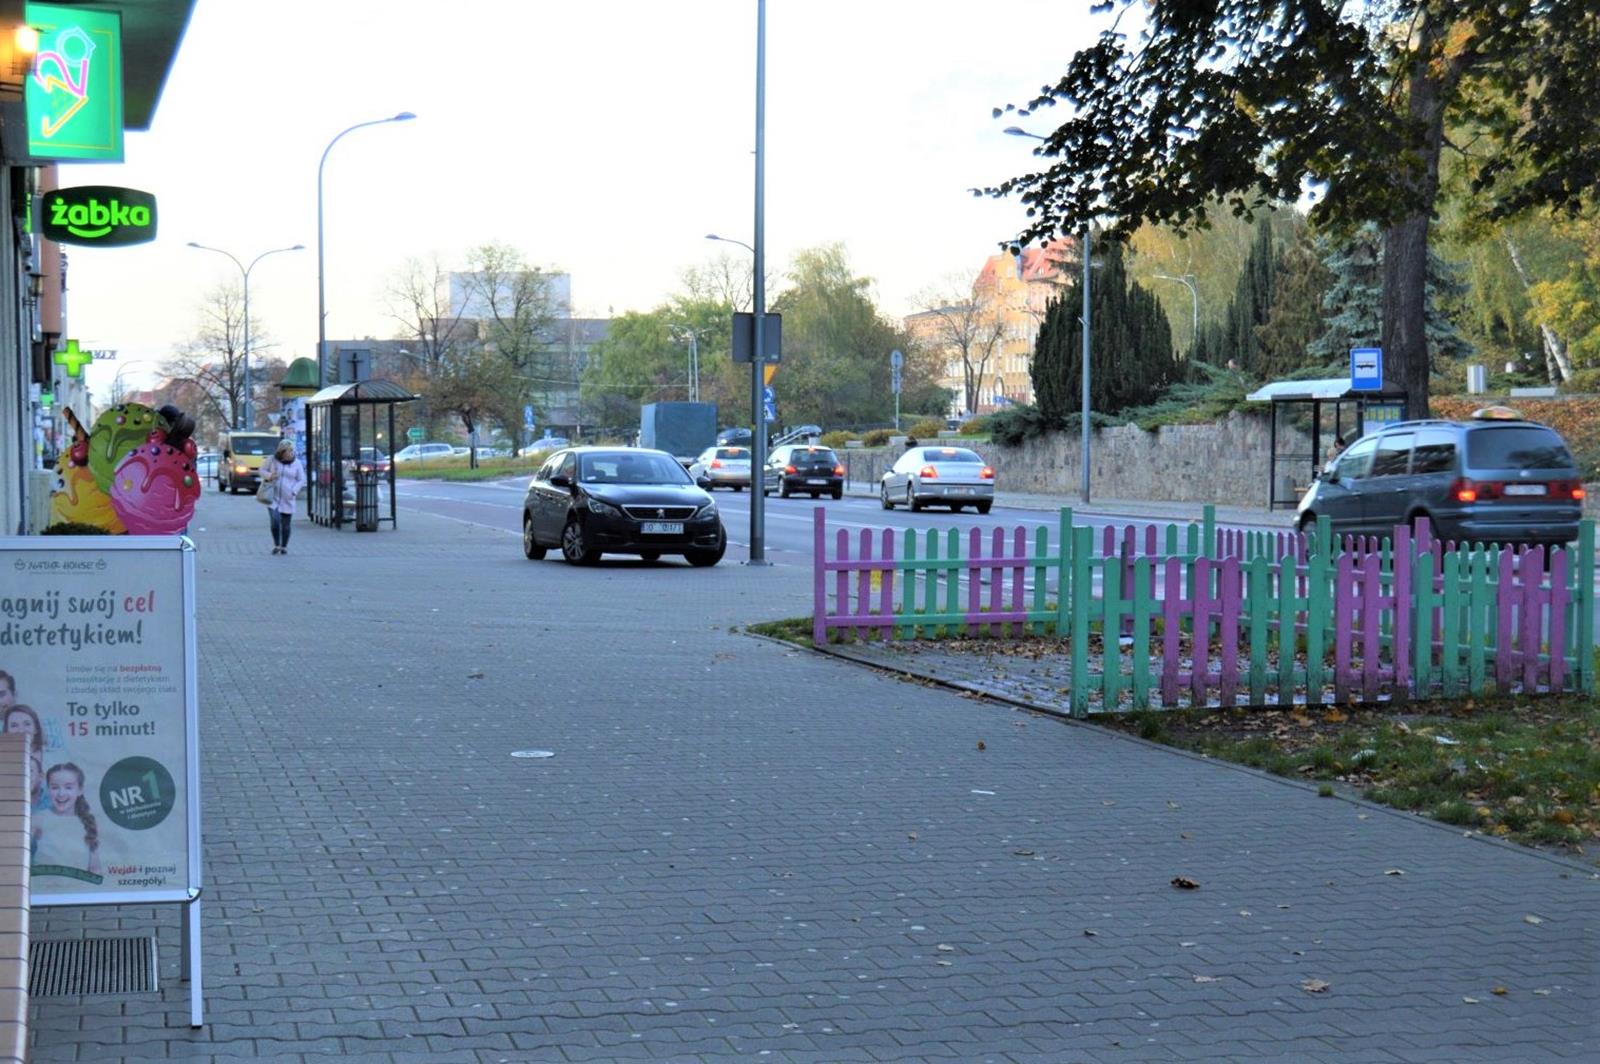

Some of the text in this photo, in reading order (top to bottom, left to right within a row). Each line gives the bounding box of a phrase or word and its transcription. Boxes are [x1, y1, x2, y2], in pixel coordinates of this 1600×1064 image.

[51, 198, 150, 226] żabka
[68, 590, 116, 619] swój
[124, 590, 156, 613] cel
[1, 619, 143, 651] dietetykiem!
[66, 701, 140, 720] To tylko
[68, 721, 155, 737] 15 minut!
[109, 786, 144, 809] NR
[142, 769, 161, 800] 1
[145, 864, 176, 875] poznaj
